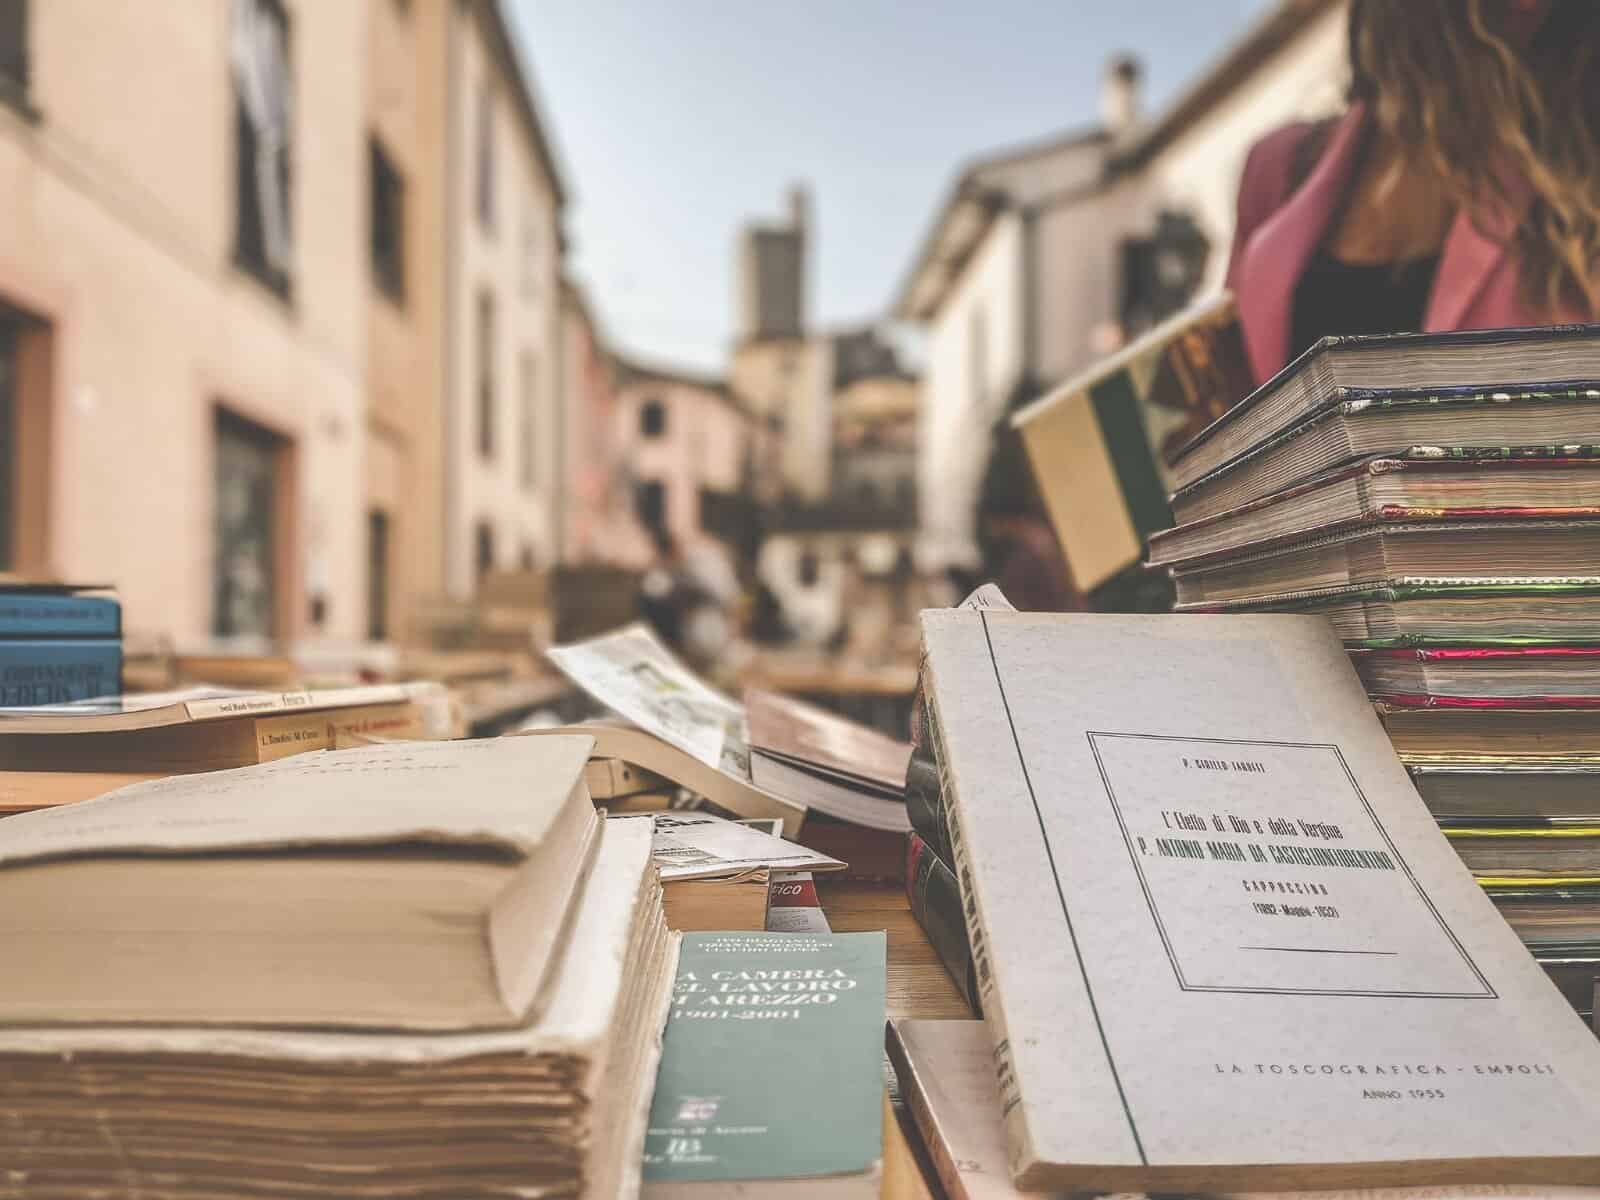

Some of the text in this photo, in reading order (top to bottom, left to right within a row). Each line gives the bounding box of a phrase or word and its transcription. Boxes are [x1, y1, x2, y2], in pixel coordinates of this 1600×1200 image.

[1211, 813, 1226, 833] di
[1227, 814, 1252, 834] Dio
[1252, 820, 1264, 834] e
[1267, 817, 1298, 836] della
[1297, 818, 1344, 840] Vergine
[1136, 836, 1153, 856] P.
[1154, 837, 1205, 859] ANTONIO
[1205, 841, 1248, 862] MARIA
[1247, 843, 1268, 863] DA
[1242, 879, 1329, 895] CAPPUCCINO
[711, 969, 847, 981] CAMERA
[719, 980, 857, 993] LAVORO
[700, 993, 838, 1006] AREZZO
[1214, 1063, 1242, 1075] LA
[1255, 1063, 1449, 1076] TOSCOGRAFICA
[1473, 1063, 1556, 1076] EMPOLI
[1362, 1088, 1402, 1100] ANNO
